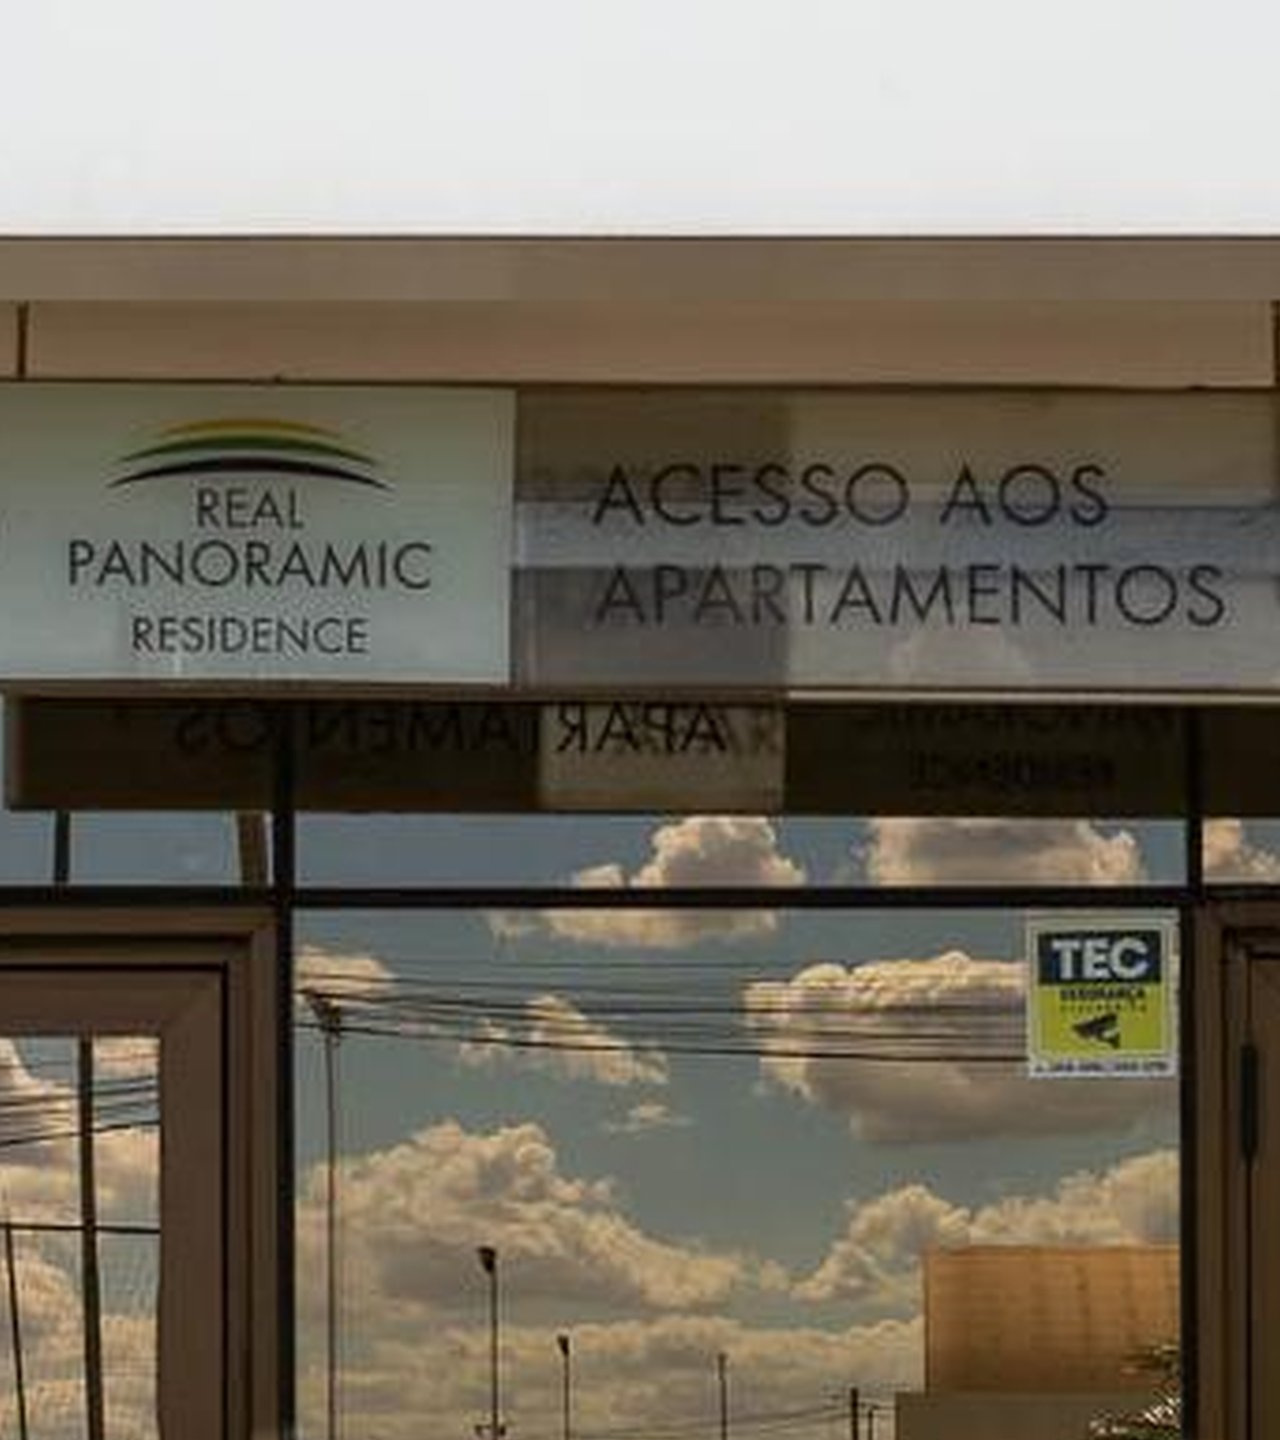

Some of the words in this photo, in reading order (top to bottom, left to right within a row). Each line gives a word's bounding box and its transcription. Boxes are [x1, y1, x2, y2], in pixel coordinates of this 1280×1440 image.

[195, 487, 305, 529] REAL
[591, 462, 911, 527] ACESSO
[939, 462, 1112, 527] AOS
[68, 538, 434, 591] PANORAMIC
[592, 563, 1226, 628] APARTAMENTOS
[131, 616, 370, 655] RESIDENCE
[1051, 936, 1150, 981] TEC
